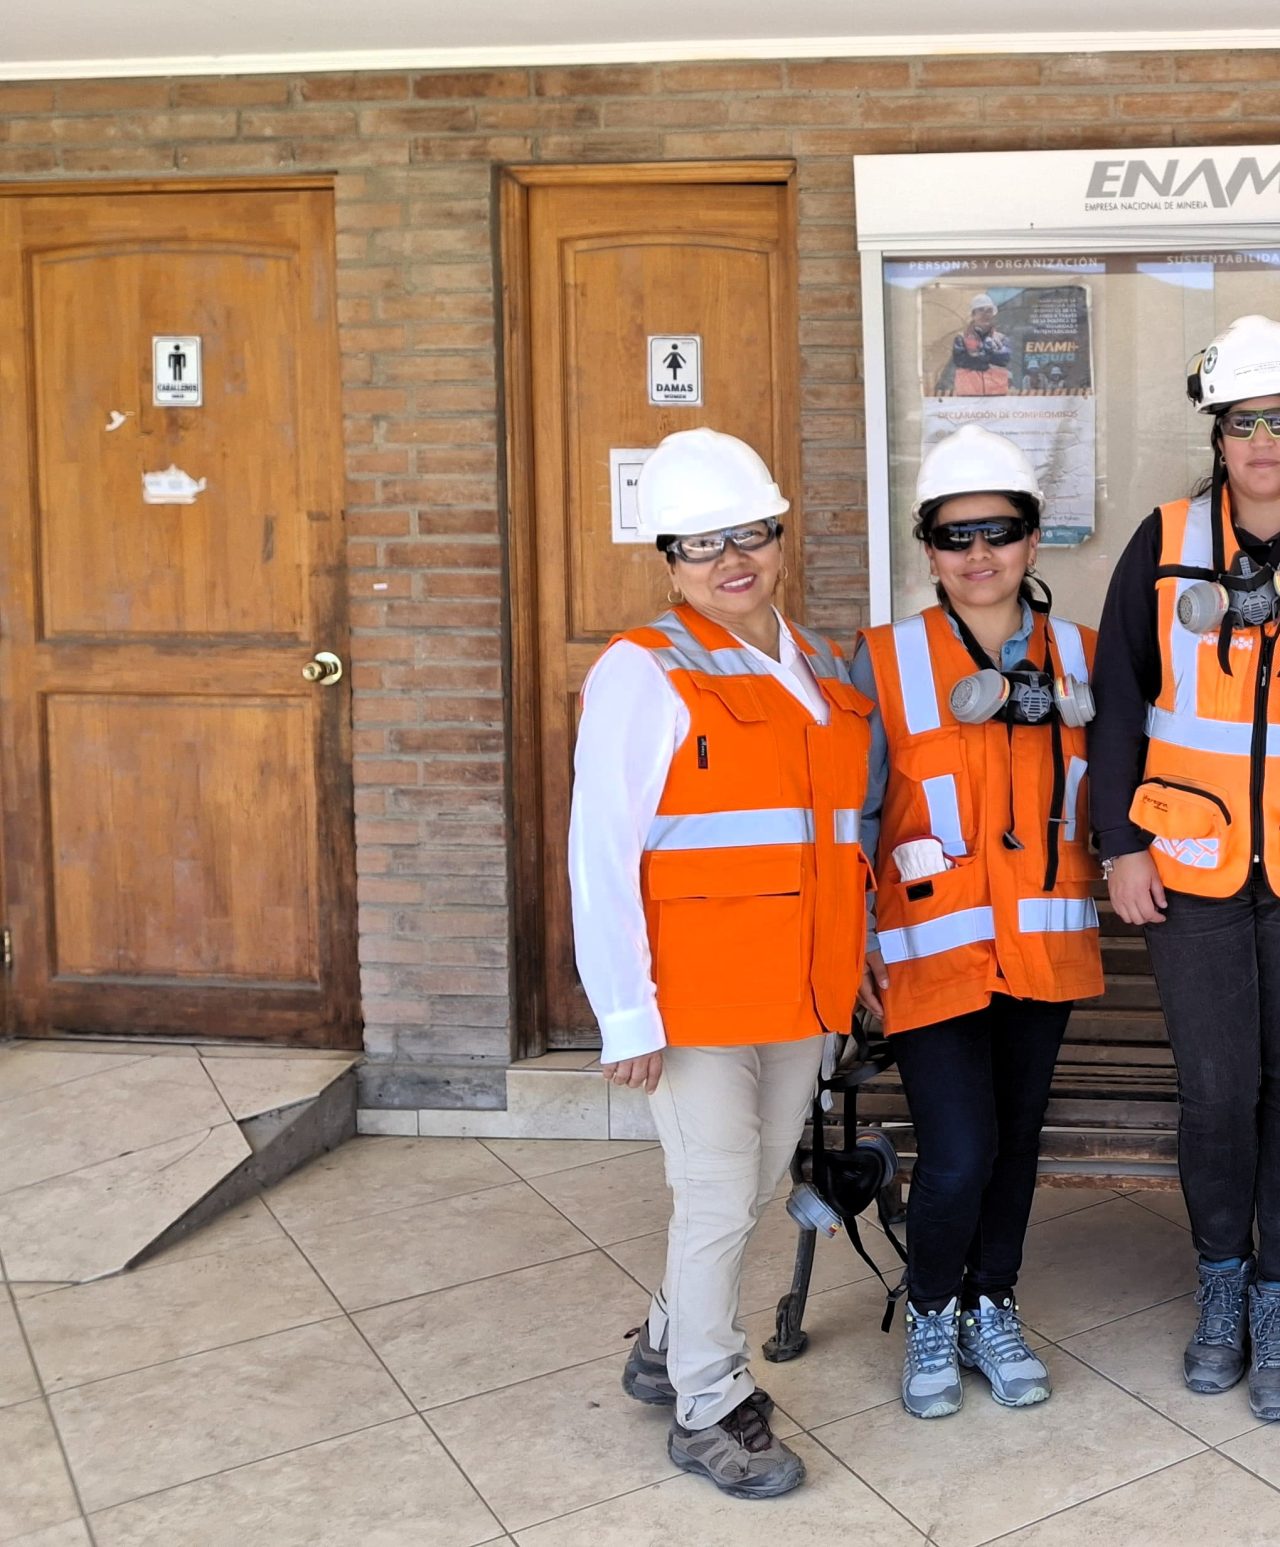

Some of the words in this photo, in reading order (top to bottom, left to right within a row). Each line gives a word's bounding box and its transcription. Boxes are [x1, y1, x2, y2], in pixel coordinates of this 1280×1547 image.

[1085, 202, 1118, 211] EMPRESA
[1120, 201, 1162, 211] NACIONAL
[1164, 201, 1174, 210] DE
[908, 260, 978, 271] PERSONAS
[983, 259, 991, 269] Y
[994, 256, 1098, 270] ORGANIZACIÓN
[656, 383, 694, 392] DAMAS
